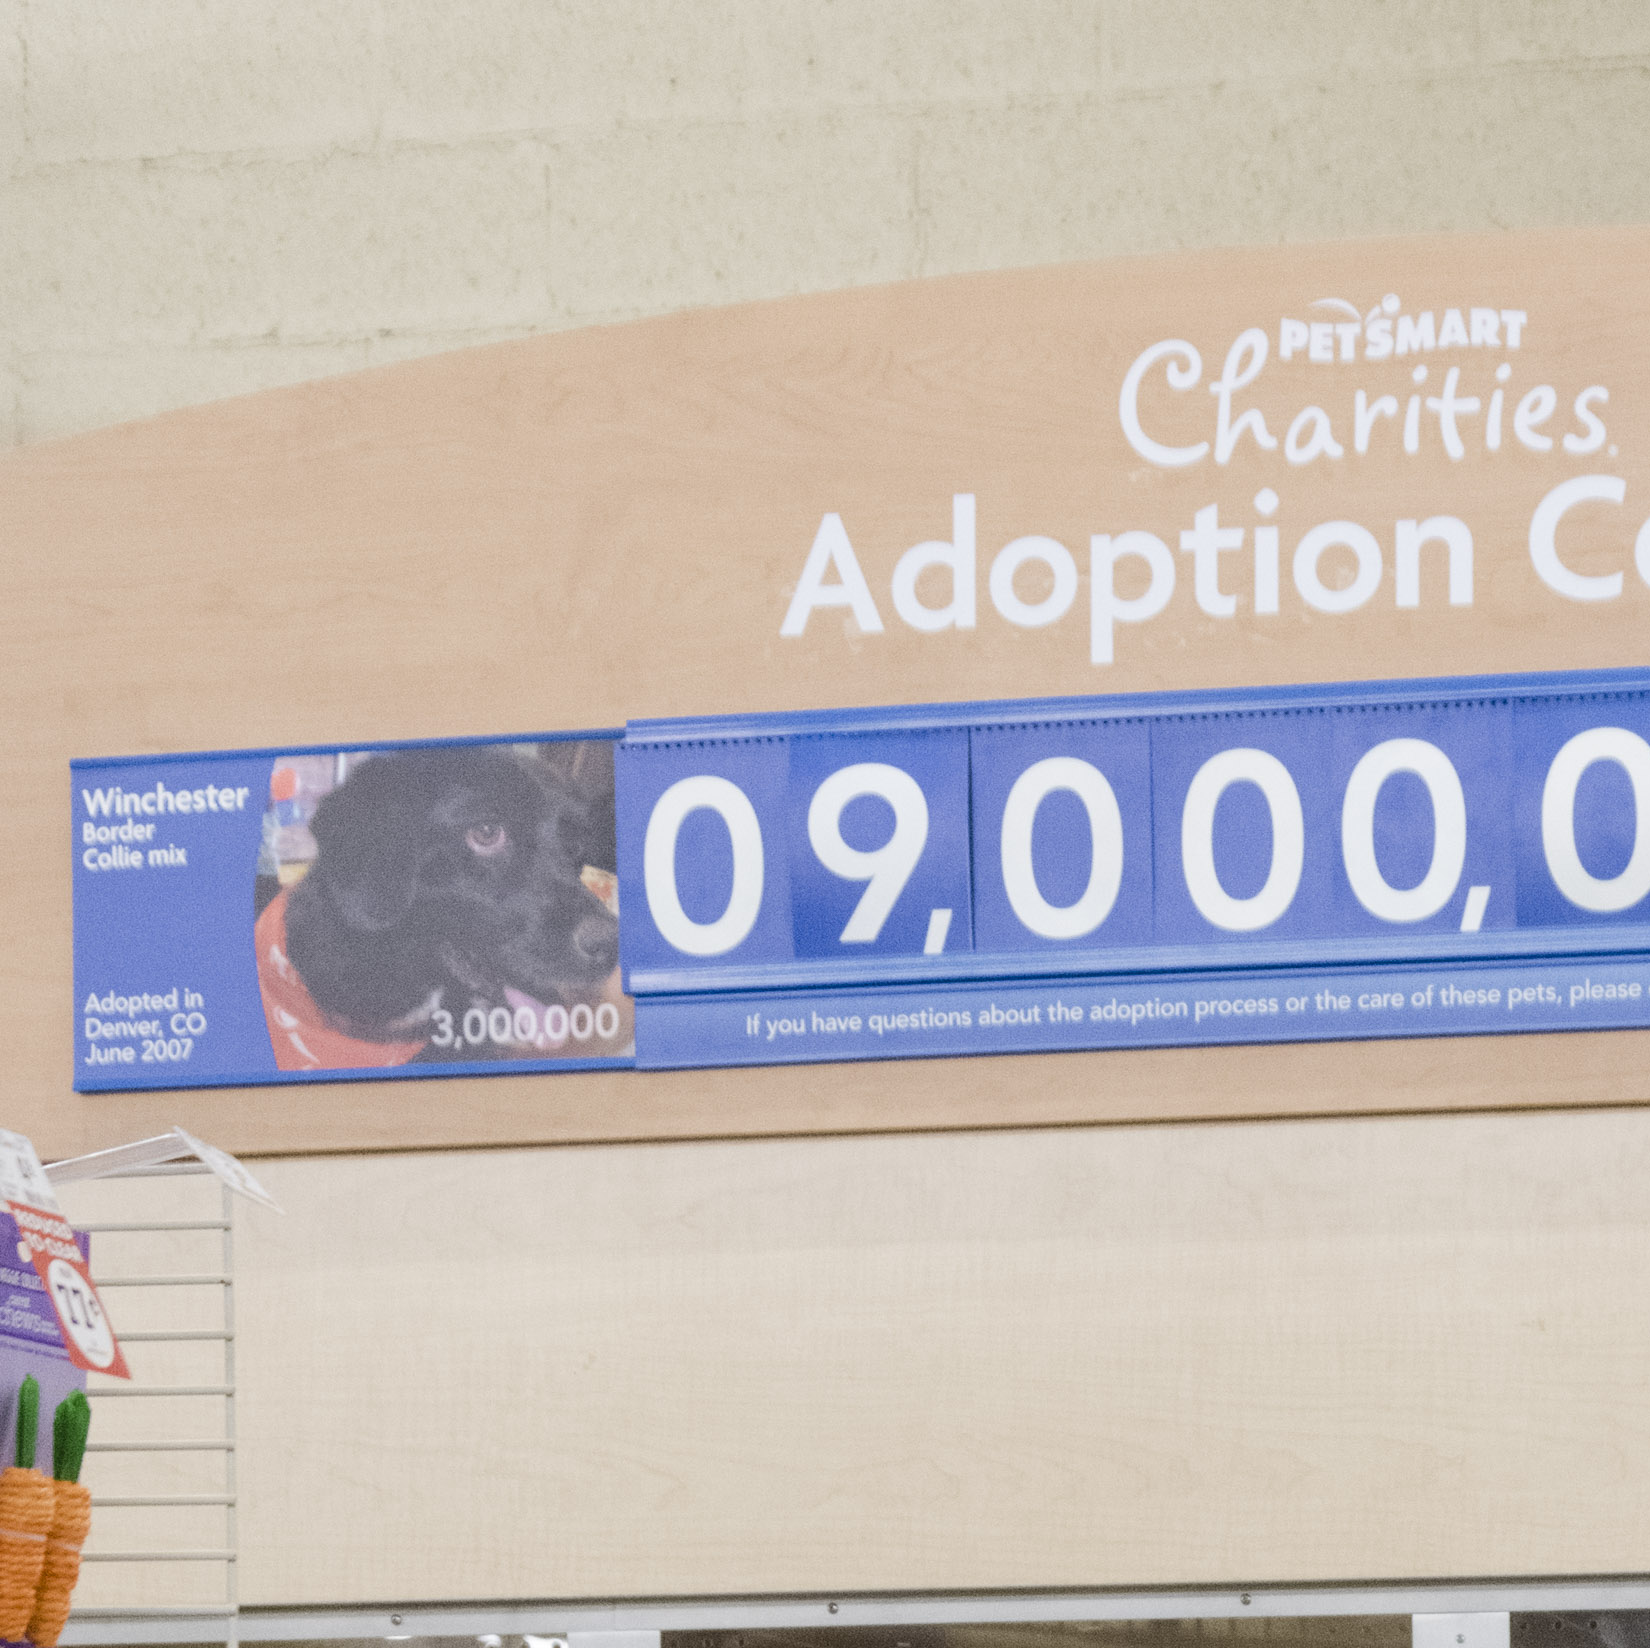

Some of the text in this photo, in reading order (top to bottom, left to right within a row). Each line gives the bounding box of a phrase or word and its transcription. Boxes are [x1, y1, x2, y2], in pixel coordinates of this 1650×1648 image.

[1279, 306, 1528, 363] PETSMART
[1118, 327, 1610, 467] Charities
[778, 489, 1475, 664] Adoption
[82, 782, 250, 818] Winchester
[83, 819, 156, 844] Border
[82, 843, 187, 870] Collie mix
[84, 988, 204, 1017] Adopted in
[746, 1012, 761, 1036] If
[766, 1018, 806, 1040] you
[811, 1011, 863, 1033] have
[868, 1008, 972, 1034] questions
[978, 1003, 1041, 1026] about
[1046, 1000, 1084, 1023] the
[1089, 998, 1188, 1024] adoption
[1194, 998, 1279, 1022] process
[1285, 996, 1309, 1013] or
[1314, 989, 1352, 1011] the
[1357, 992, 1405, 1009] care
[1410, 984, 1434, 1007] of
[1439, 984, 1501, 1006] these
[1507, 984, 1562, 1009] pets,
[1569, 979, 1642, 1006] please
[85, 1012, 207, 1040] Denver, CO
[430, 1003, 619, 1049] 3,000,000
[84, 1038, 193, 1065] June 2007
